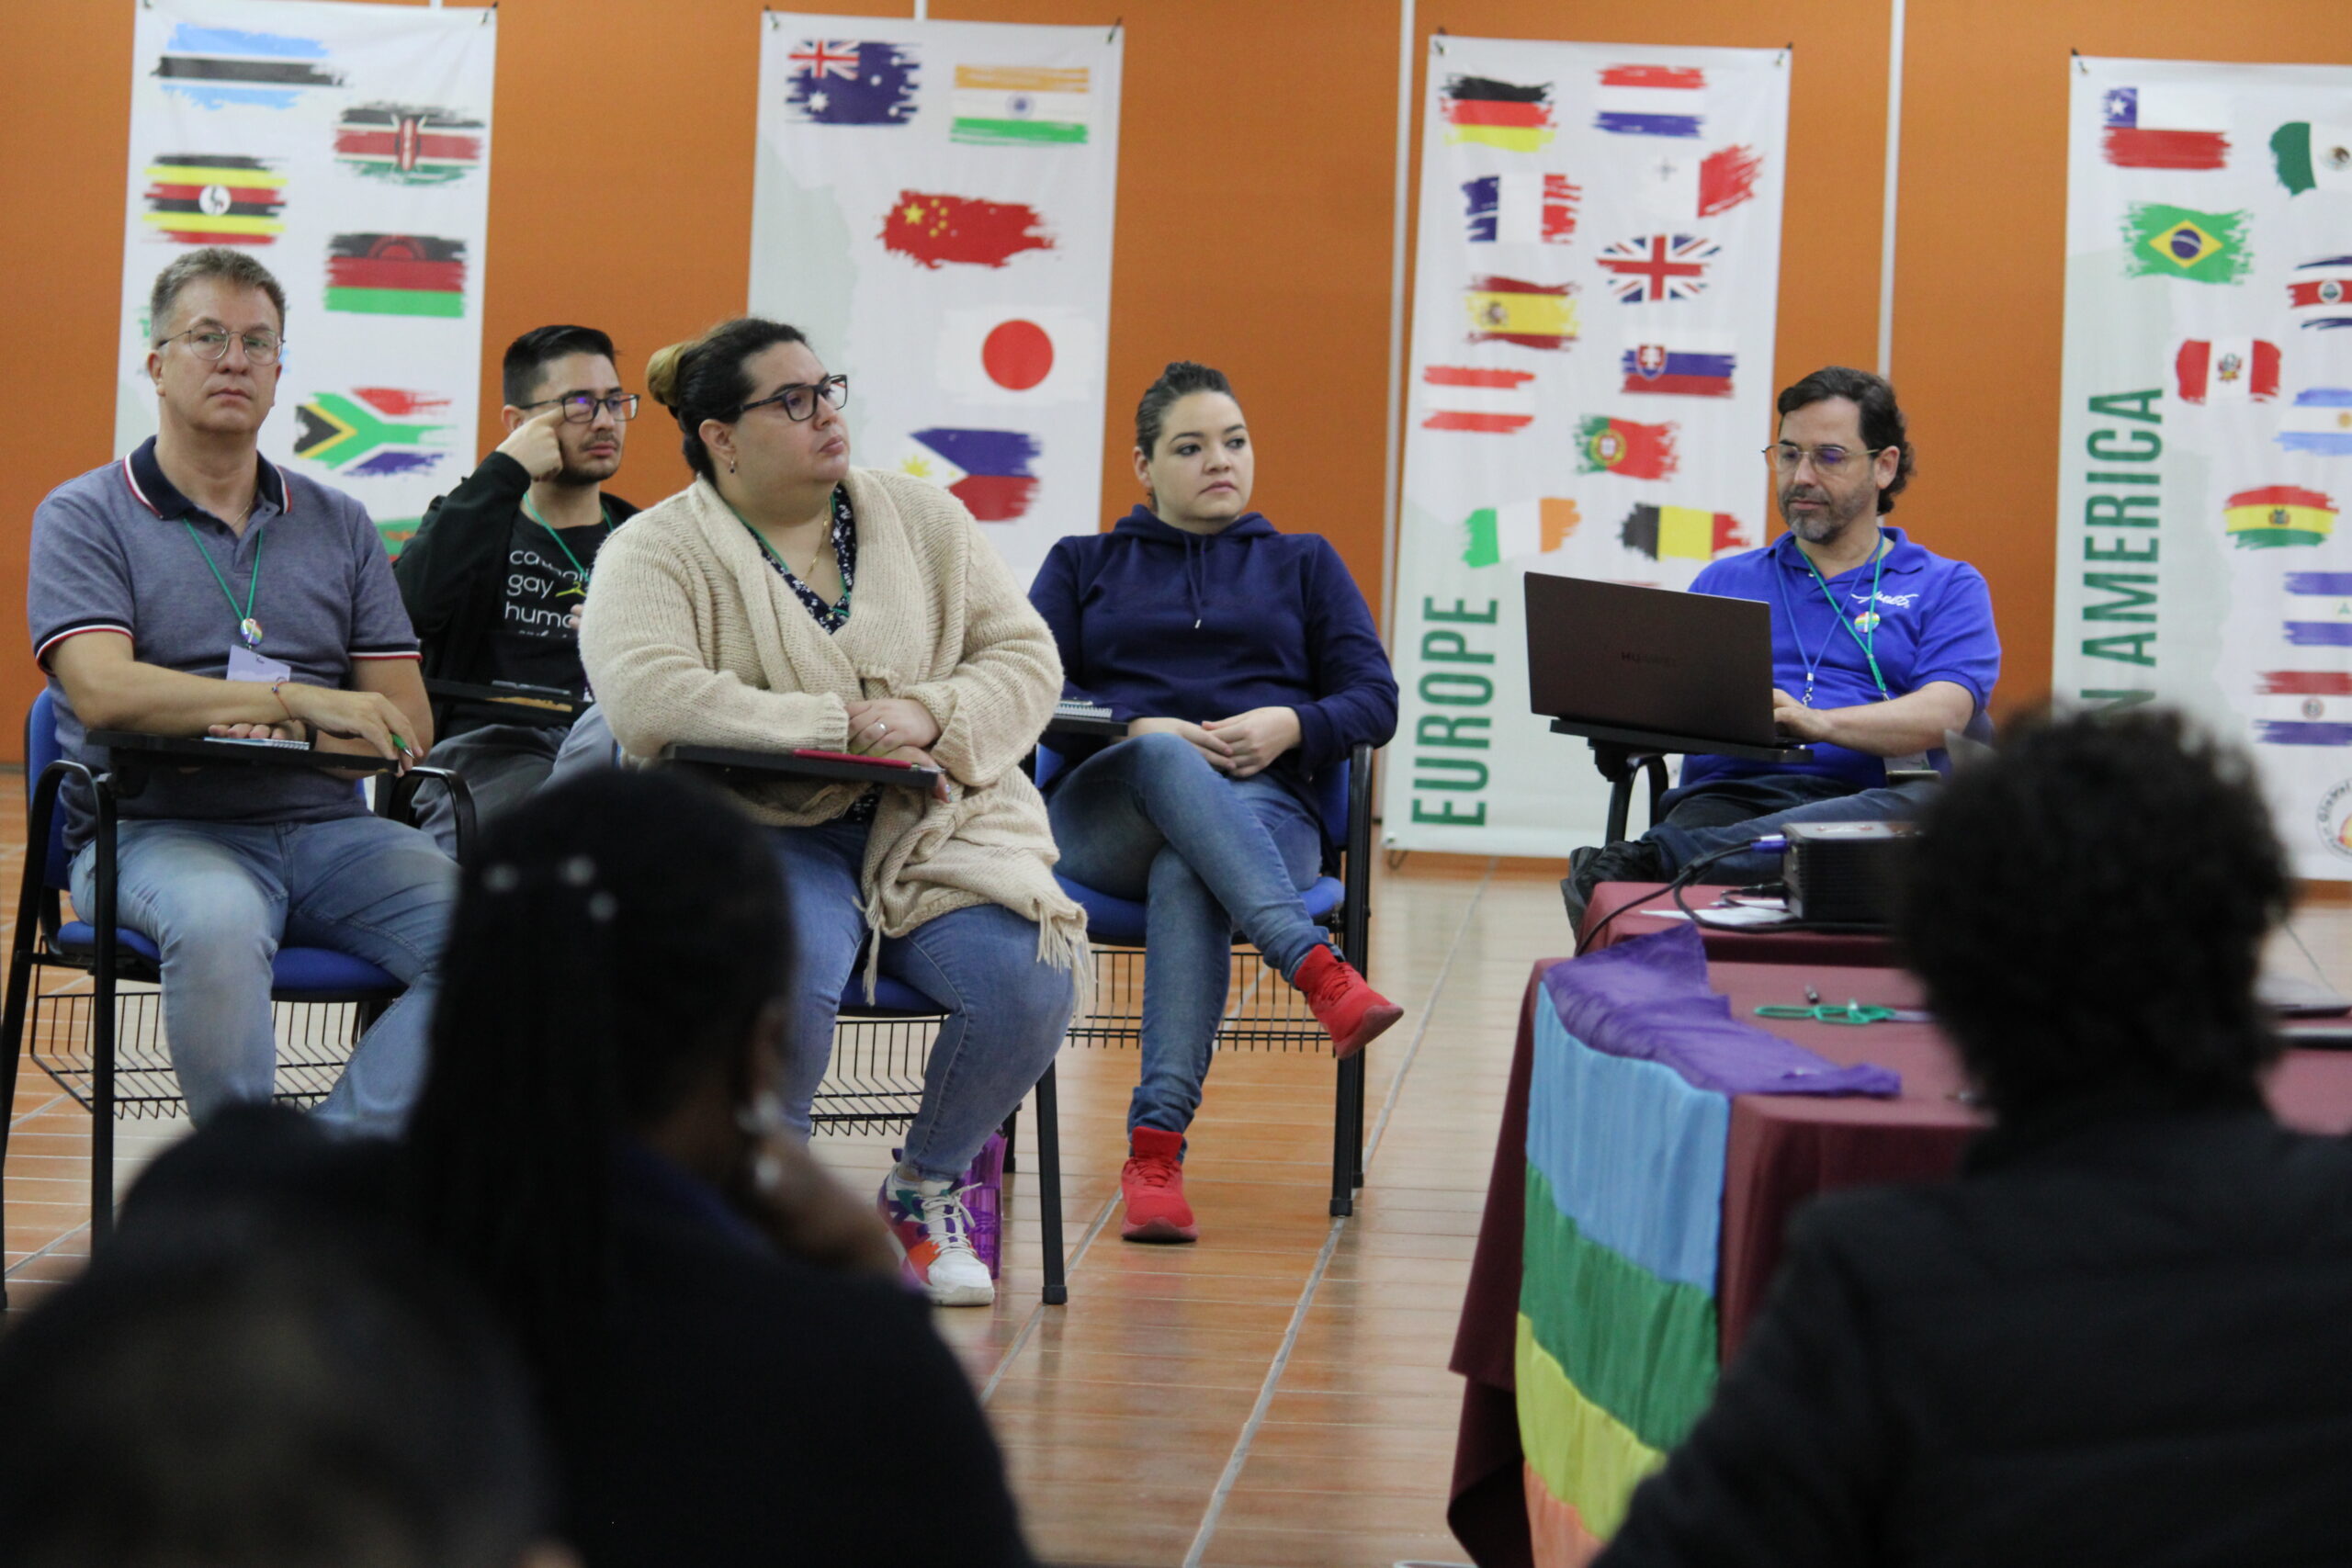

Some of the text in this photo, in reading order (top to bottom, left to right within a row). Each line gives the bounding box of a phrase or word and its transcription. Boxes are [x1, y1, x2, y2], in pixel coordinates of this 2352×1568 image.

[506, 574, 555, 600] gay
[2080, 388, 2164, 667] AMERICA
[1410, 595, 1499, 828] EUROPE
